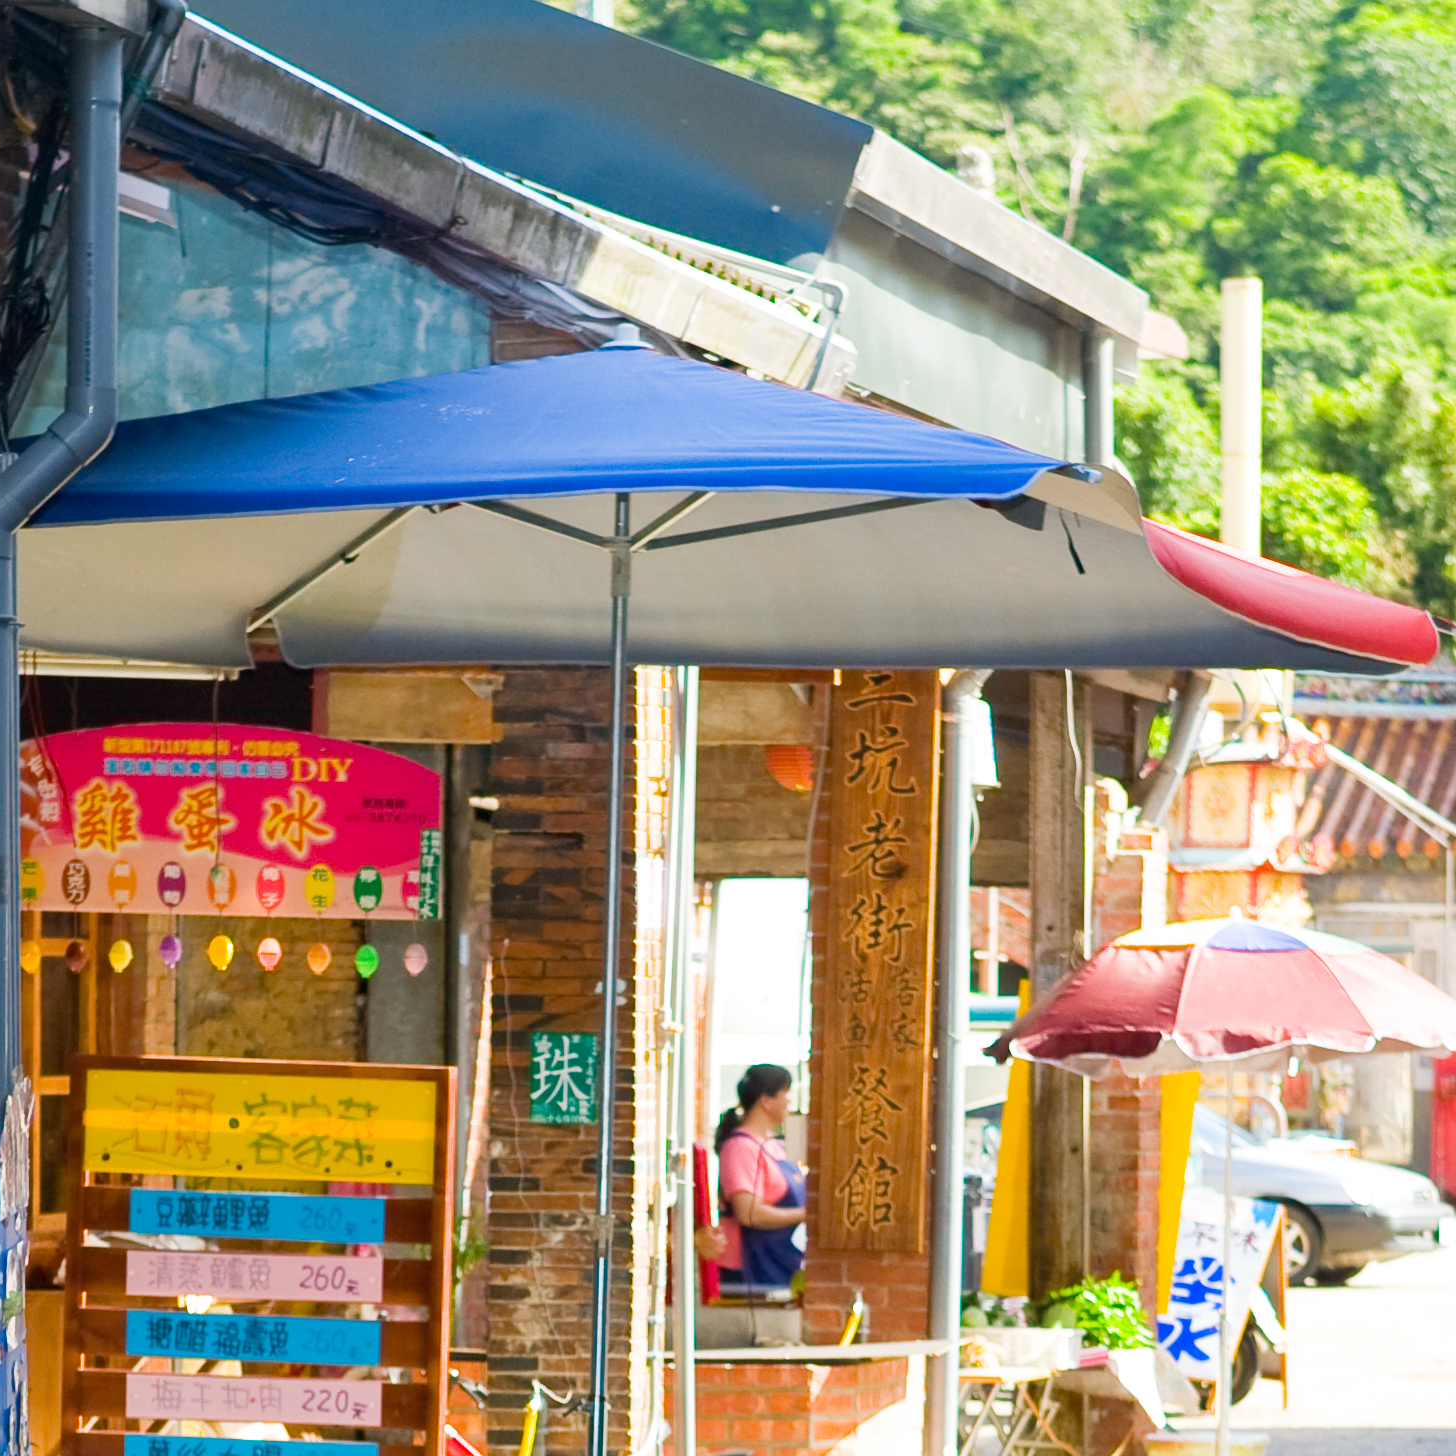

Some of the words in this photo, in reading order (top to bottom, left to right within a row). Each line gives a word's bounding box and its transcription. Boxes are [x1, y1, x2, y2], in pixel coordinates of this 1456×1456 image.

[291, 757, 353, 782] DIY
[75, 780, 334, 857] 雞蛋冰
[845, 669, 918, 966] 三坑老街
[67, 863, 86, 903] 巧克力
[311, 868, 328, 907] 花生
[887, 969, 919, 1053] 客家
[530, 1034, 591, 1112] 珠
[836, 1065, 902, 1232] 餐館
[156, 1196, 270, 1233] 豆瓣鯉魚
[148, 1254, 271, 1291] 清蒸鱸魚
[299, 1265, 360, 1296] 260元
[147, 1315, 289, 1358] 糖醋福壽魚
[302, 1389, 367, 1421] 220元
